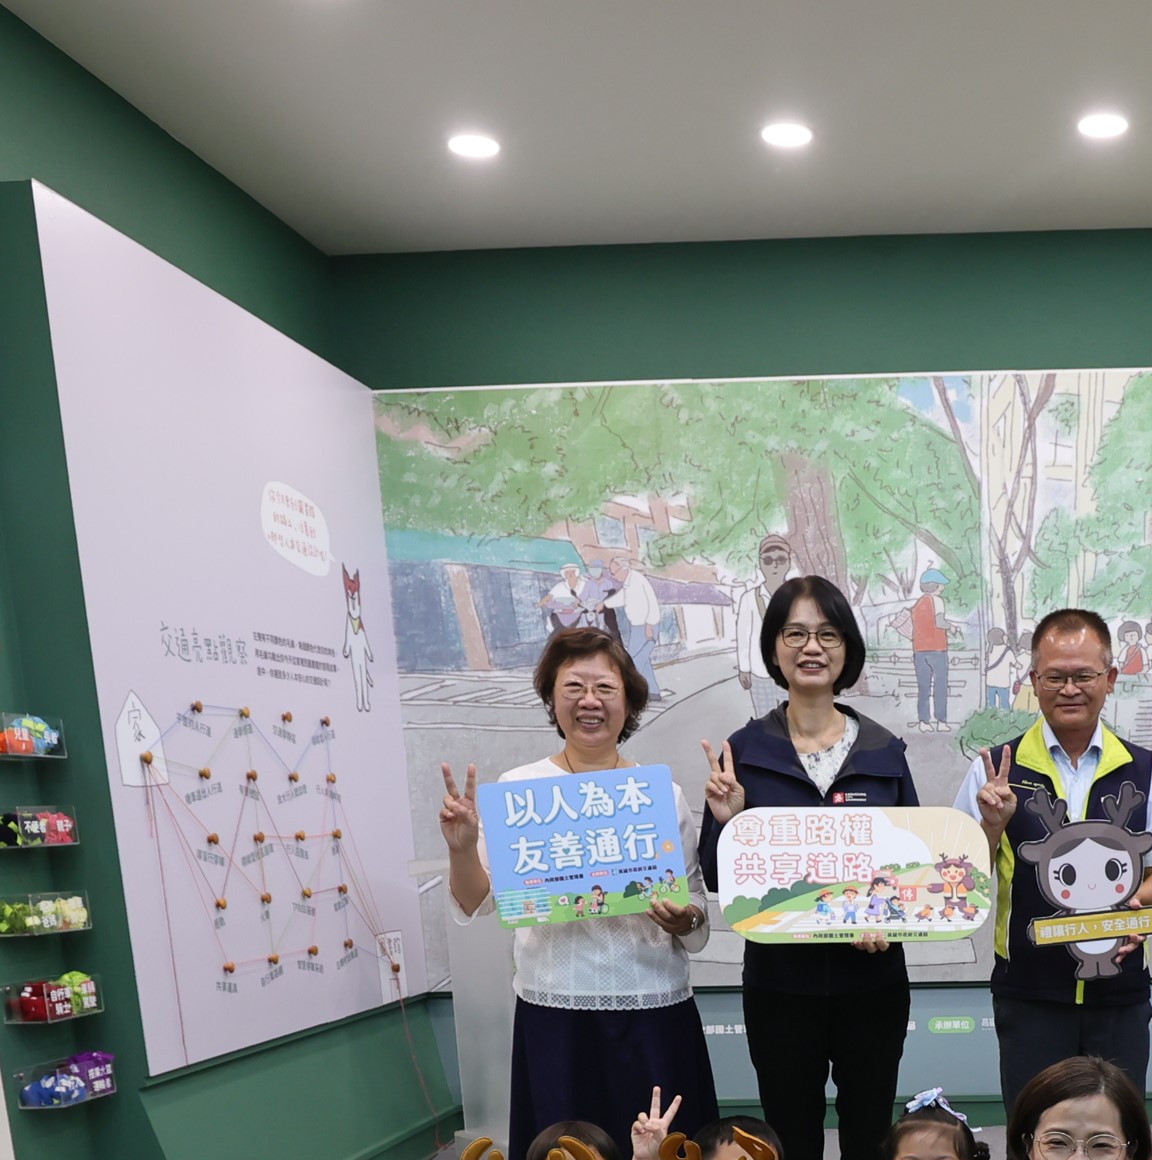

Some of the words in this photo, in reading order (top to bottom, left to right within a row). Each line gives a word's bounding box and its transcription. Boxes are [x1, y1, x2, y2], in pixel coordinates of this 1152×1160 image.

[160, 621, 248, 665] 交通亮點觀察
[128, 701, 146, 741] 家
[504, 776, 653, 828] 以人為本
[510, 823, 659, 875] 友善通行
[732, 813, 874, 847] 尊重路權
[734, 852, 874, 885] 共享道路
[1040, 915, 1151, 938] 禮讓行人，安全通行
